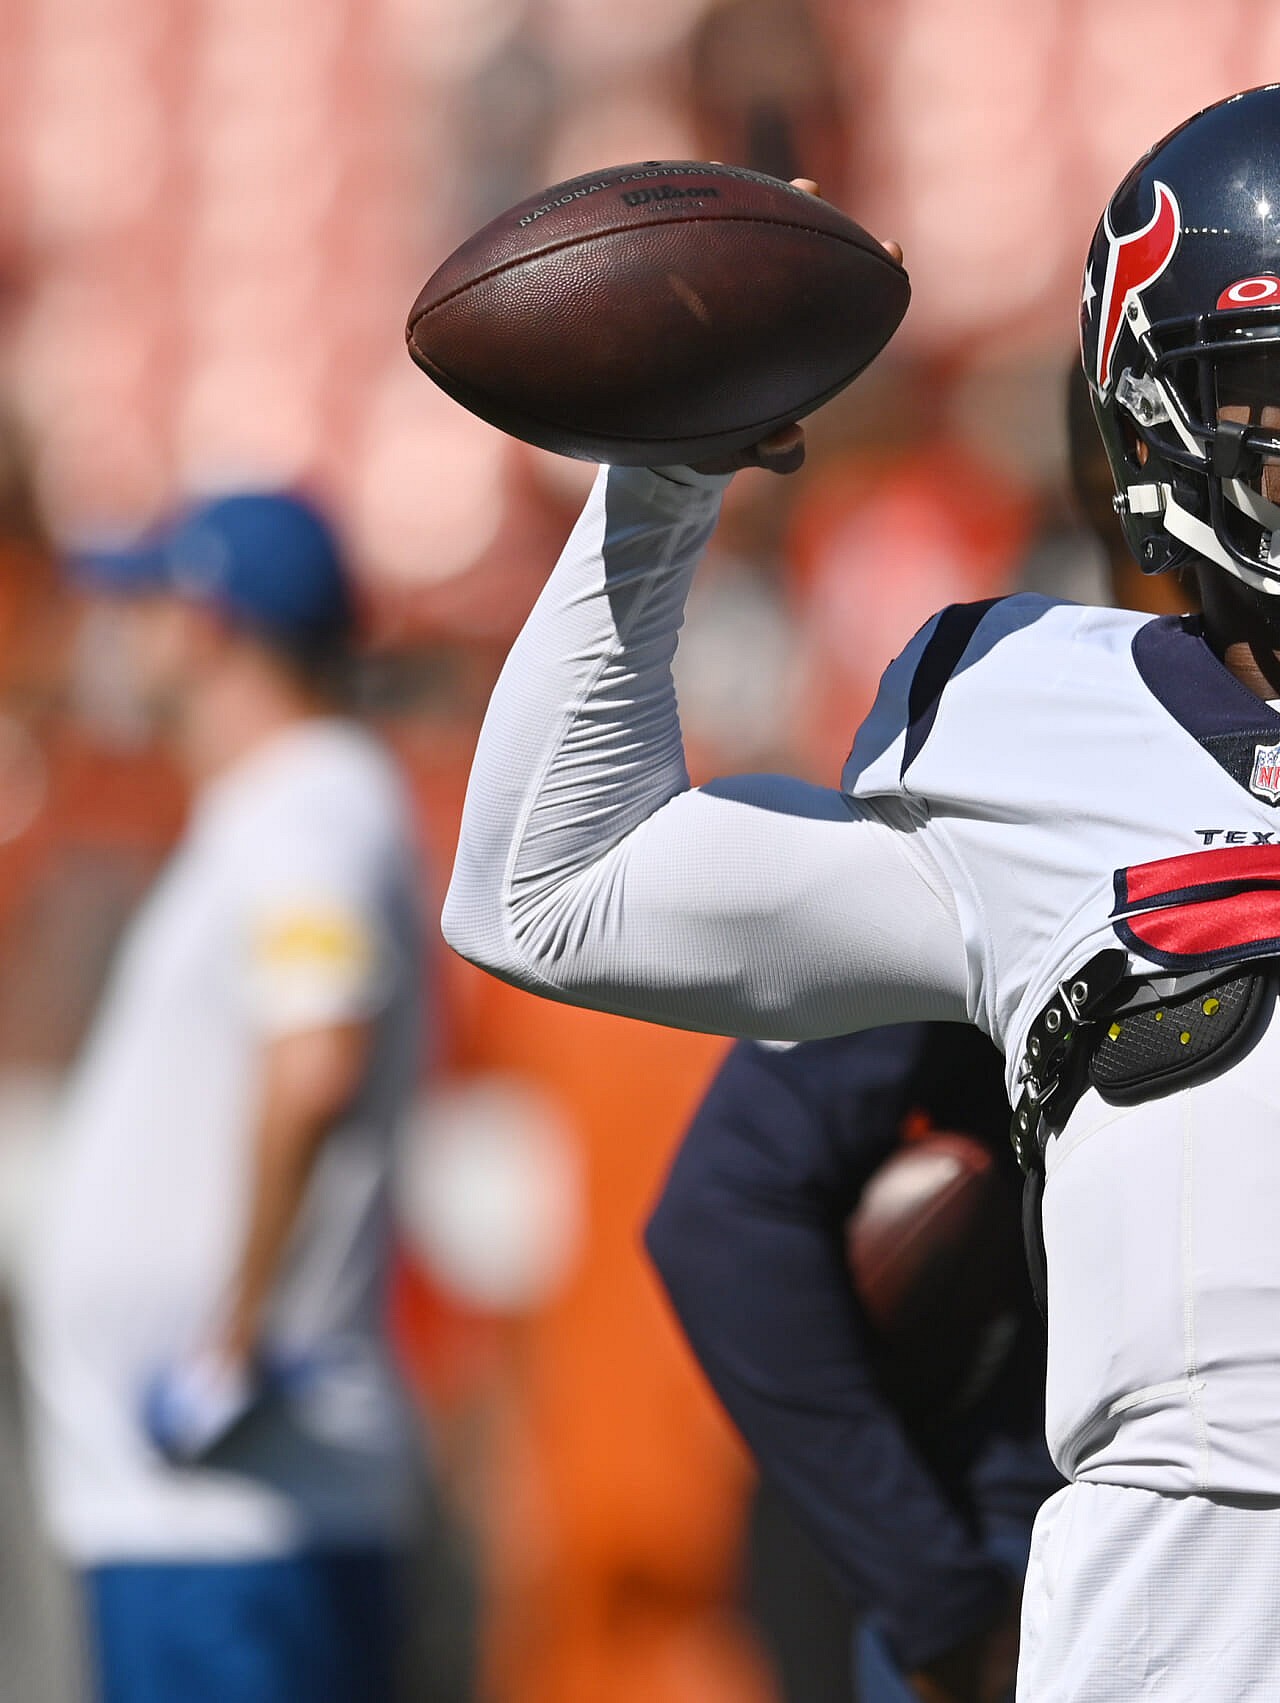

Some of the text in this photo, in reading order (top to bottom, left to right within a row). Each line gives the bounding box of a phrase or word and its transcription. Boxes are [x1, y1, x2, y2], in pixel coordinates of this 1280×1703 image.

[519, 181, 612, 228] NATIONAL
[619, 168, 719, 184] FOOTBALL
[622, 184, 720, 207] Wilson
